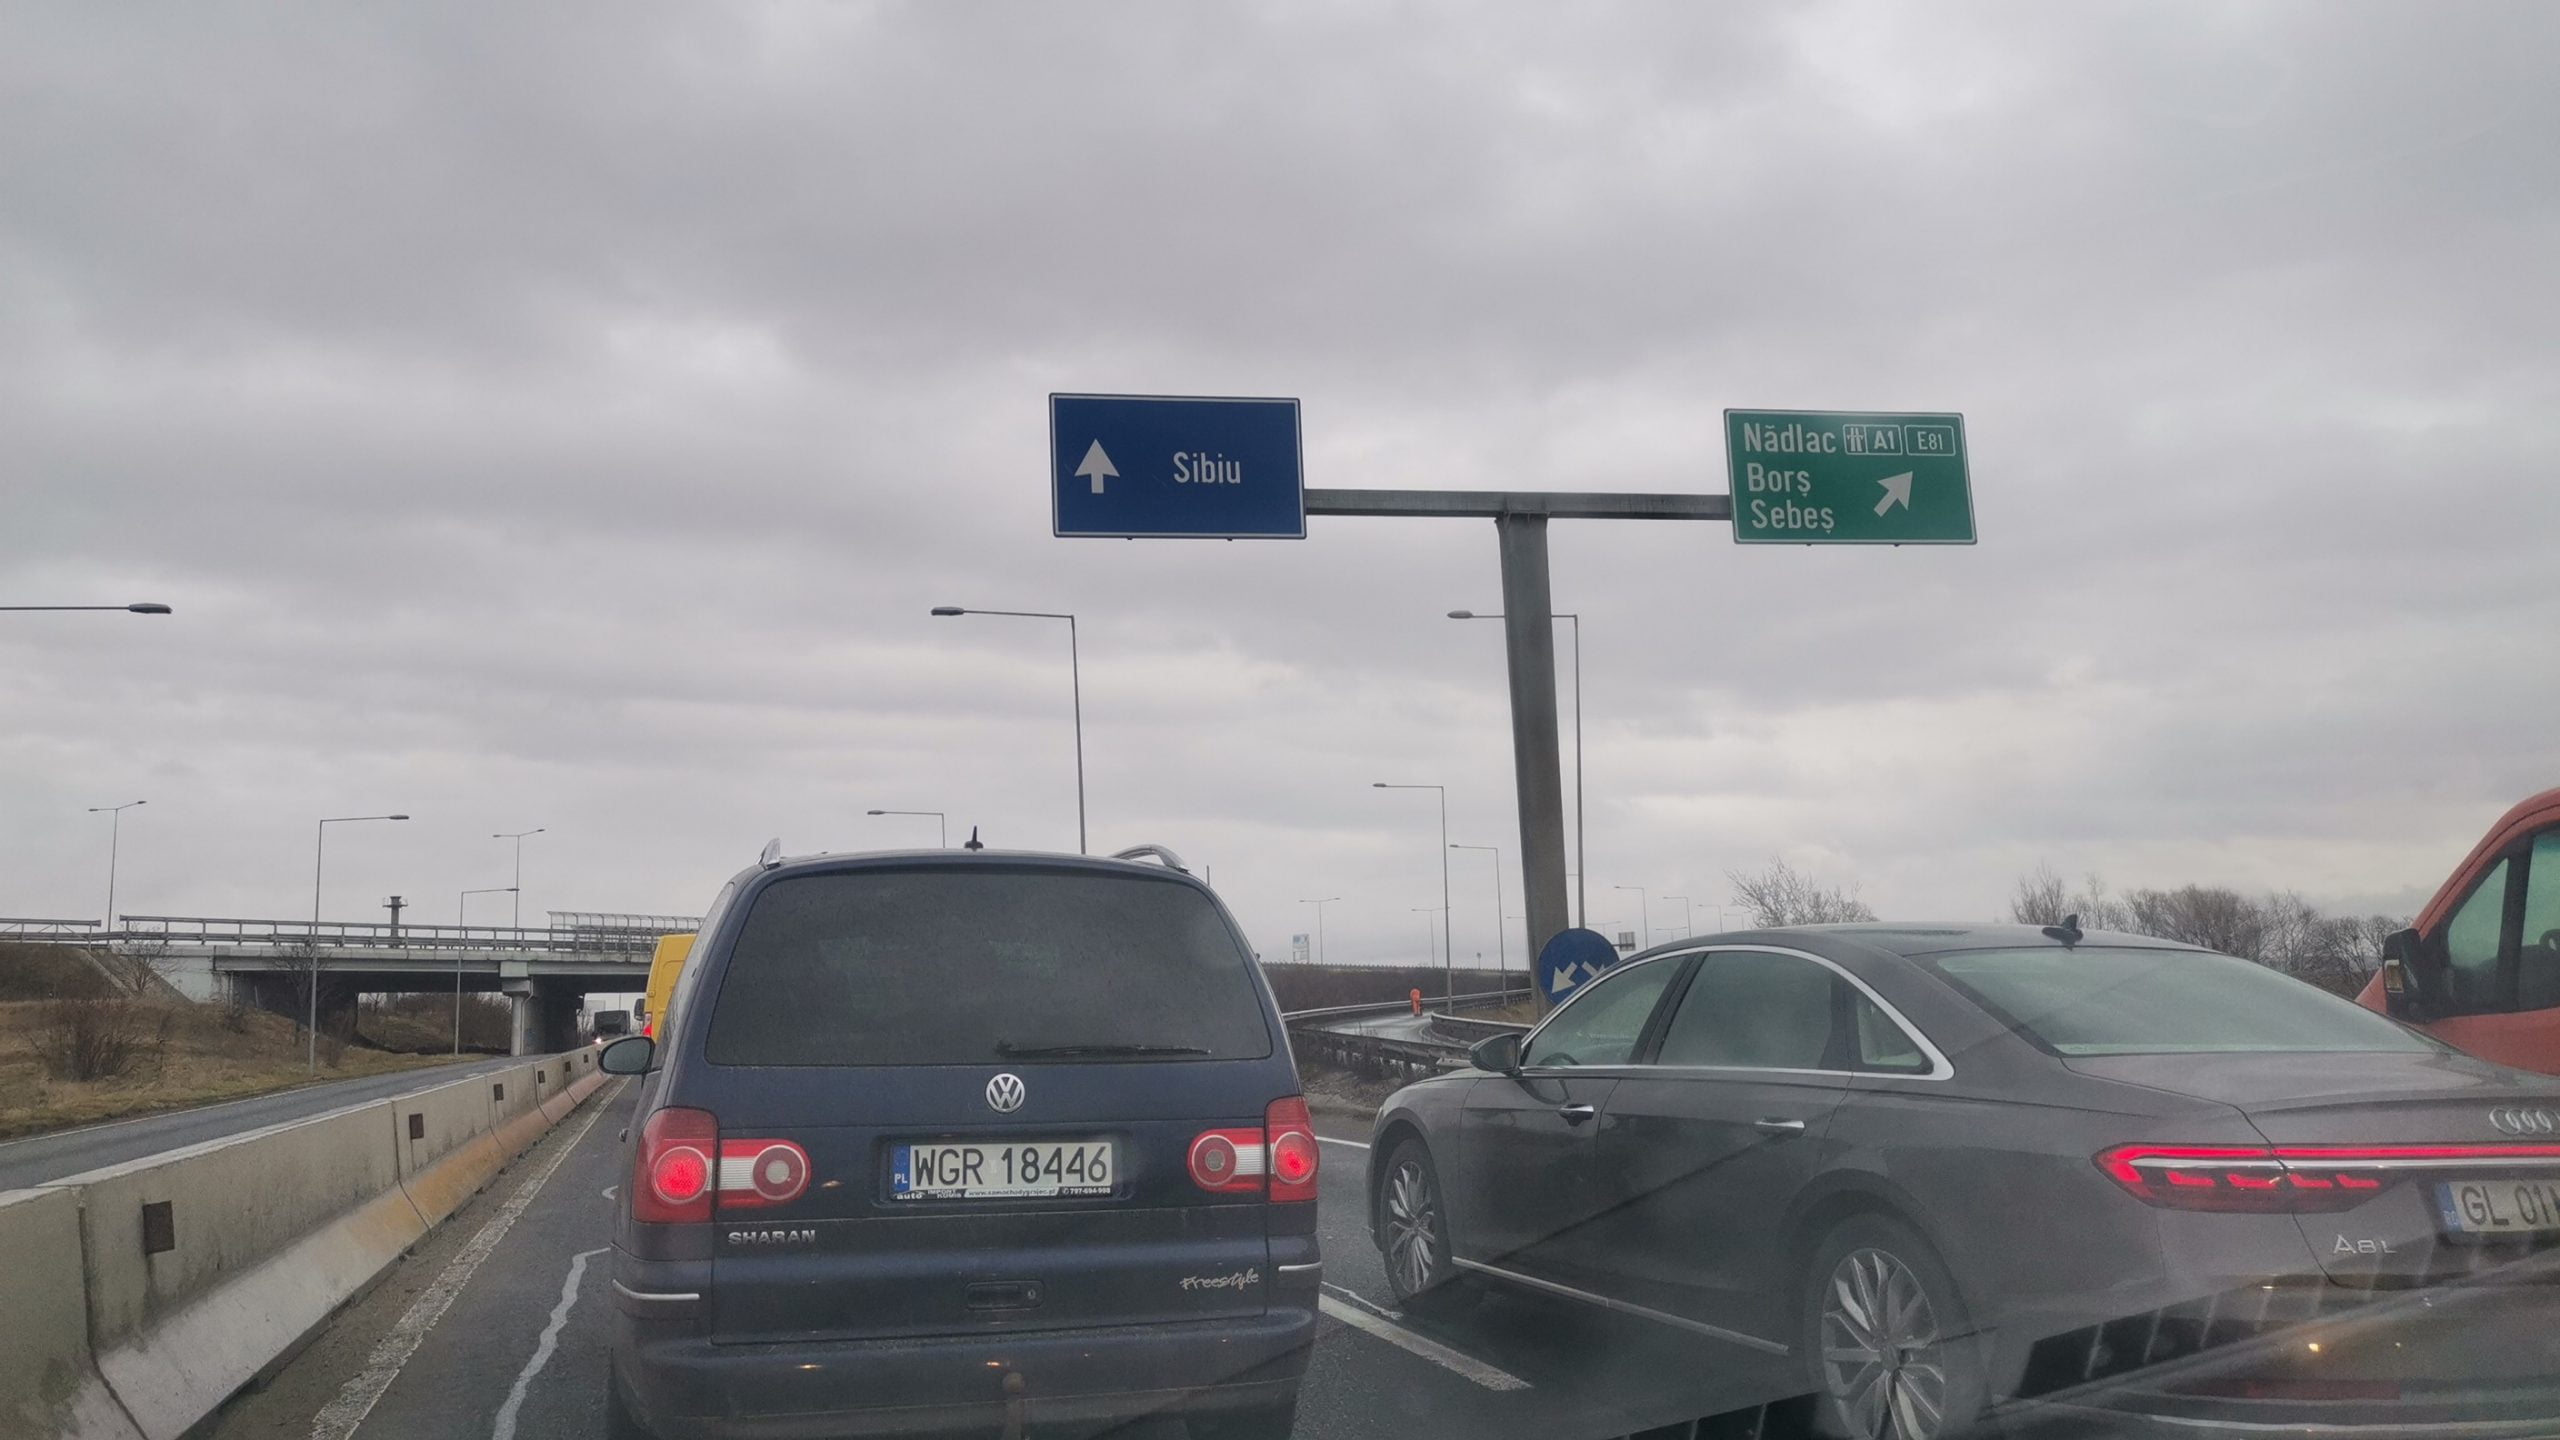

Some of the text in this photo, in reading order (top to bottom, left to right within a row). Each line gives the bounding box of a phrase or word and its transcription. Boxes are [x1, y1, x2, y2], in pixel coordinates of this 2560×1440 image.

[1743, 423, 1837, 454] Nădlac
[1873, 430, 1896, 450] A1
[1916, 431, 1944, 451] E81
[1173, 451, 1241, 484] Sibiu
[1746, 462, 1812, 497] Borș
[1750, 499, 1835, 534] Sebeș
[894, 1173, 908, 1185] PL
[914, 1146, 1107, 1187] WGR 18446
[896, 1191, 923, 1200] auto
[2461, 1185, 2509, 1227] GL
[728, 1229, 816, 1245] SHARAN
[1179, 1268, 1260, 1290] Freestyle
